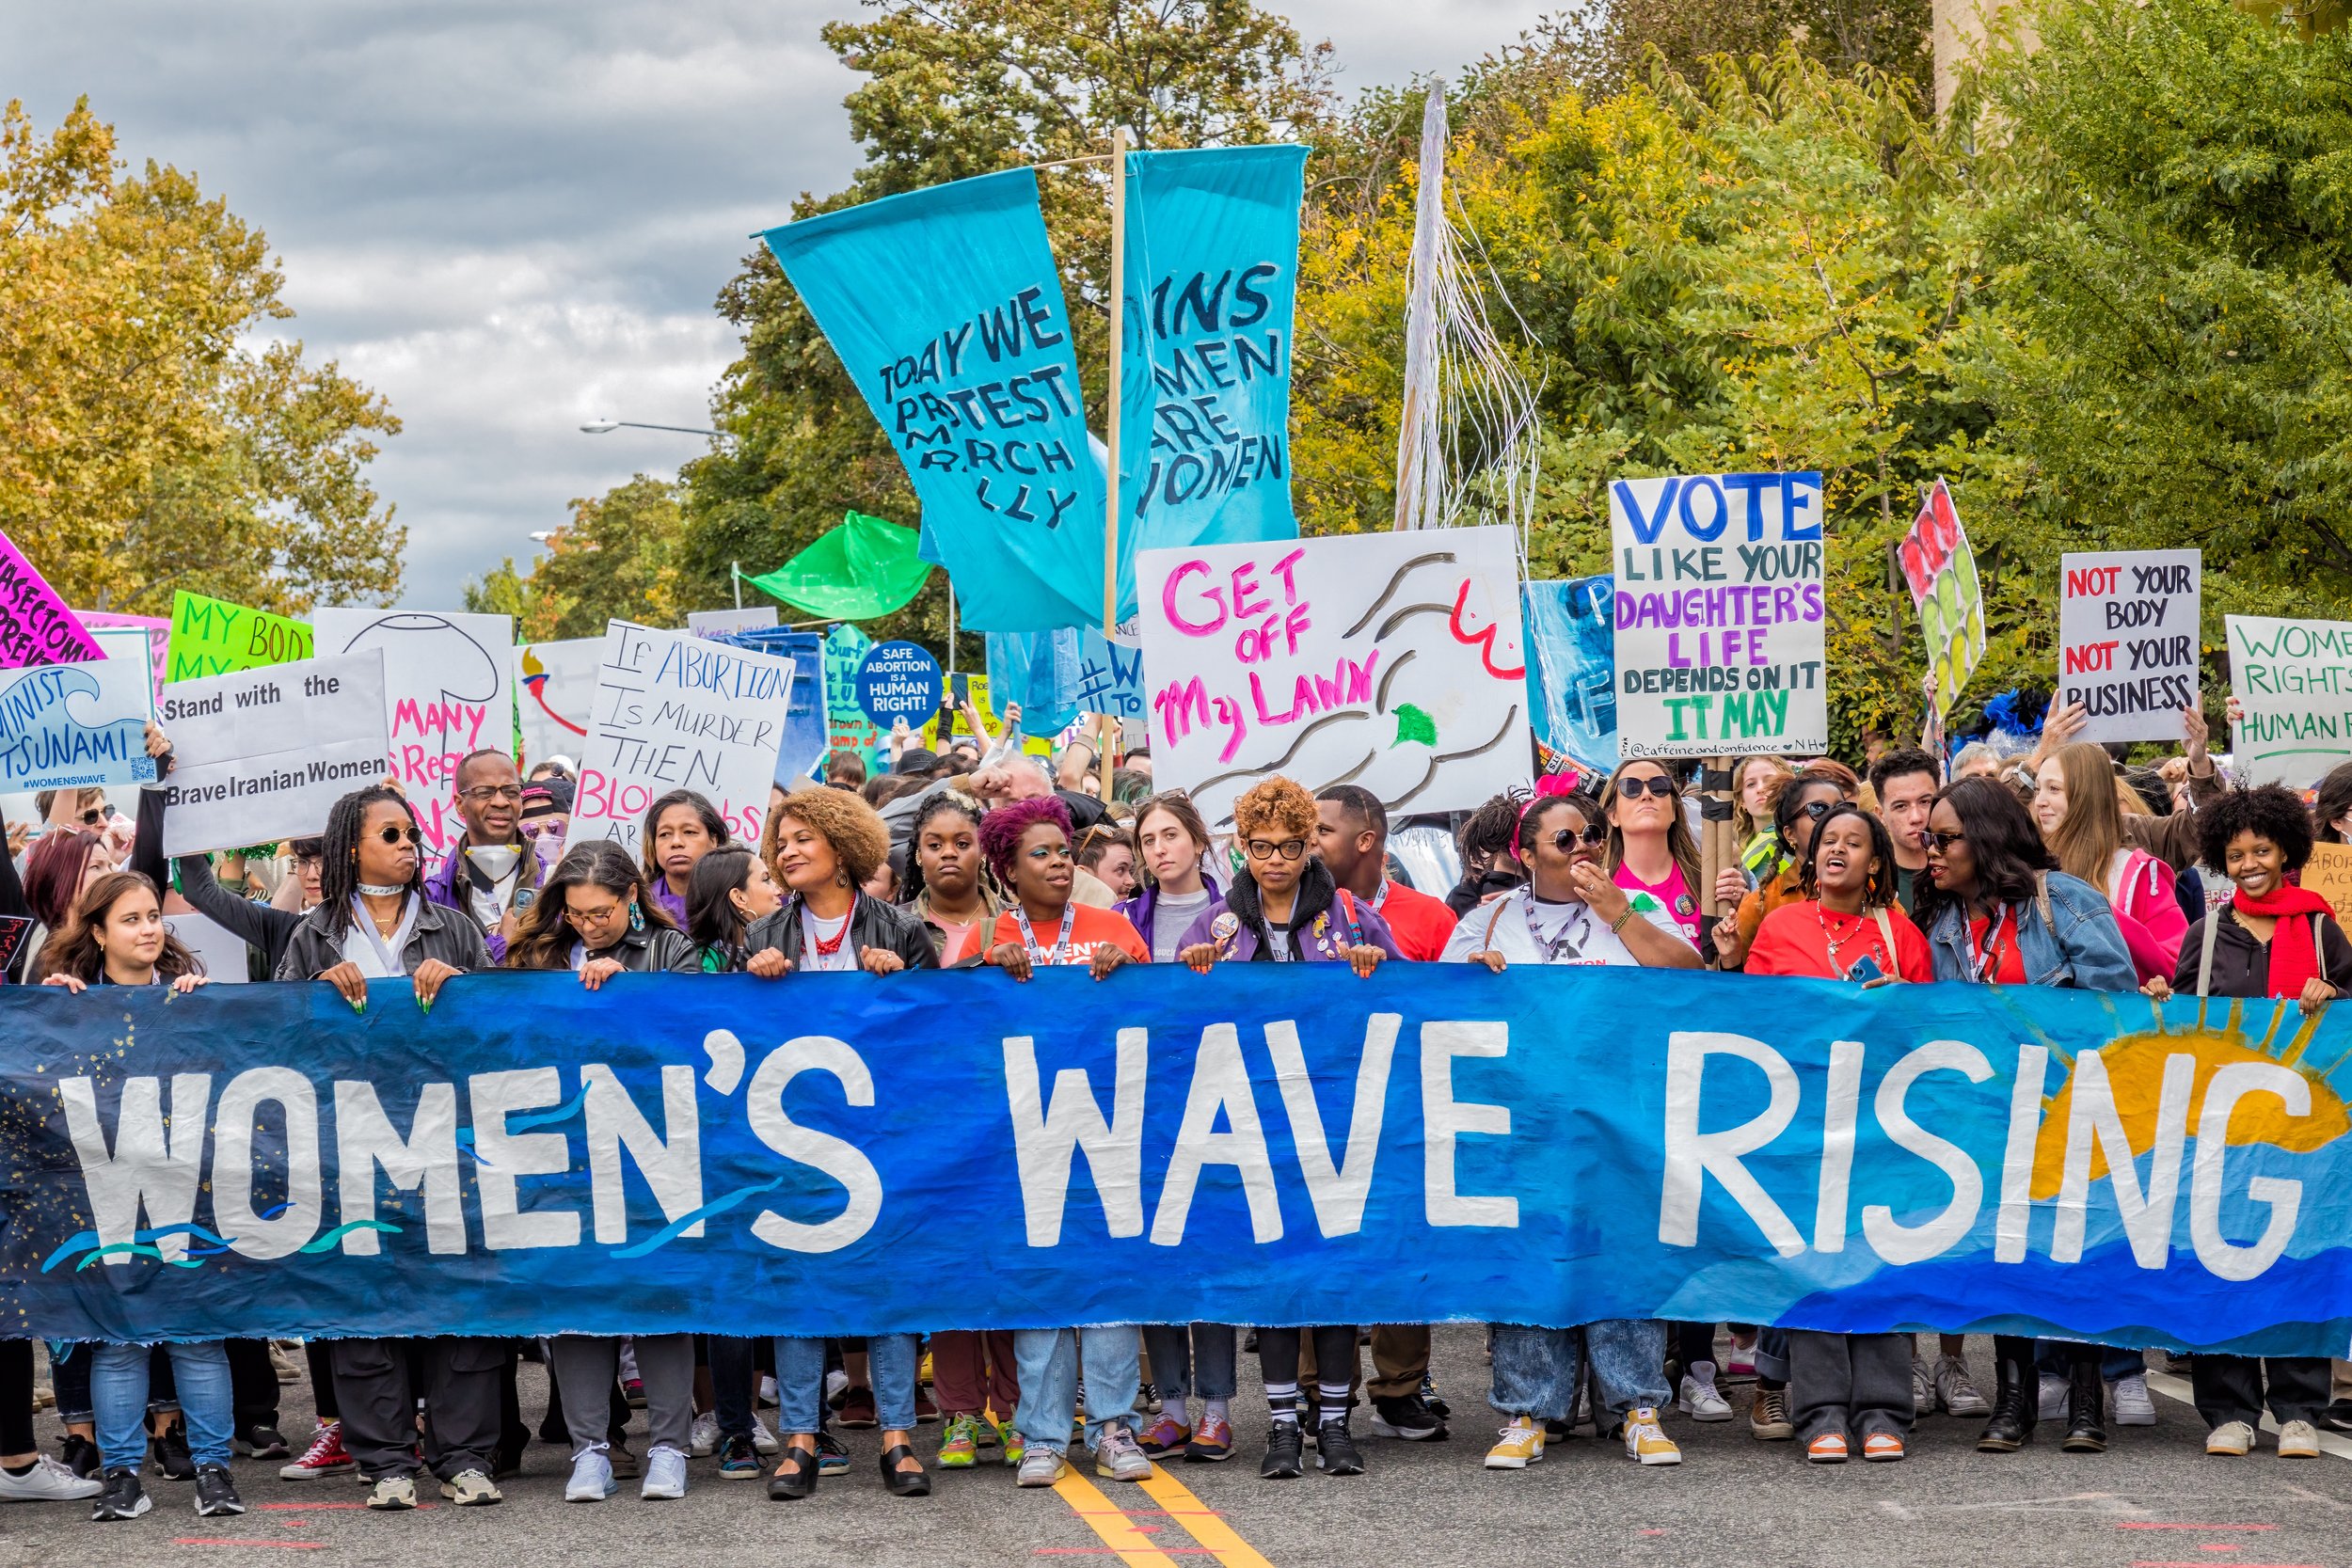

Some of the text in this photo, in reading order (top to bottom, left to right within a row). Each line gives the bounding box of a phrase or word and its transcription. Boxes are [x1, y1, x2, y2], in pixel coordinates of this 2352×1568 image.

[978, 285, 1063, 362] WE
[905, 423, 1074, 476] MRCH
[1613, 471, 1822, 545] VOTE
[1624, 542, 1821, 582] LIKE YOUR
[2068, 564, 2193, 598] NOT YOUR
[1162, 547, 1307, 638] GET
[1615, 581, 1824, 630] DAUGHTER'S
[2106, 597, 2169, 630] BODY
[182, 597, 314, 663] MY BOD
[882, 648, 914, 659] SAFE
[1234, 600, 1311, 664] OFF
[1668, 628, 1769, 669] LIFE
[2066, 635, 2193, 674] NOT YOUR
[655, 640, 791, 701] ABORTION
[866, 660, 931, 673] ABORTION
[869, 681, 930, 696] HUMAN
[1077, 640, 1145, 714] #W
[1249, 648, 1380, 727] LAWN
[1624, 661, 1820, 694] DEPENDS ON IT
[165, 692, 223, 721] Stand
[235, 682, 281, 708] with
[304, 674, 340, 697] the
[873, 696, 927, 712] RIGHT!
[1111, 692, 1142, 717] TO
[1662, 694, 1713, 741] IT
[1720, 689, 1789, 740] MAY
[2067, 673, 2193, 717] BUSINESS
[391, 698, 486, 747] MANY
[652, 701, 777, 752] MURDER
[2240, 711, 2338, 743] HUMAN
[0, 723, 127, 779] TSUNAMI
[599, 733, 723, 792] THEN,
[24, 774, 106, 788] #WOMENSWAVE
[166, 782, 227, 806] Brave
[229, 769, 305, 798] Iranian
[307, 757, 387, 783] Women
[574, 768, 653, 821] BLO
[59, 1012, 2312, 1282] WOMEN'S WAVE RISING
